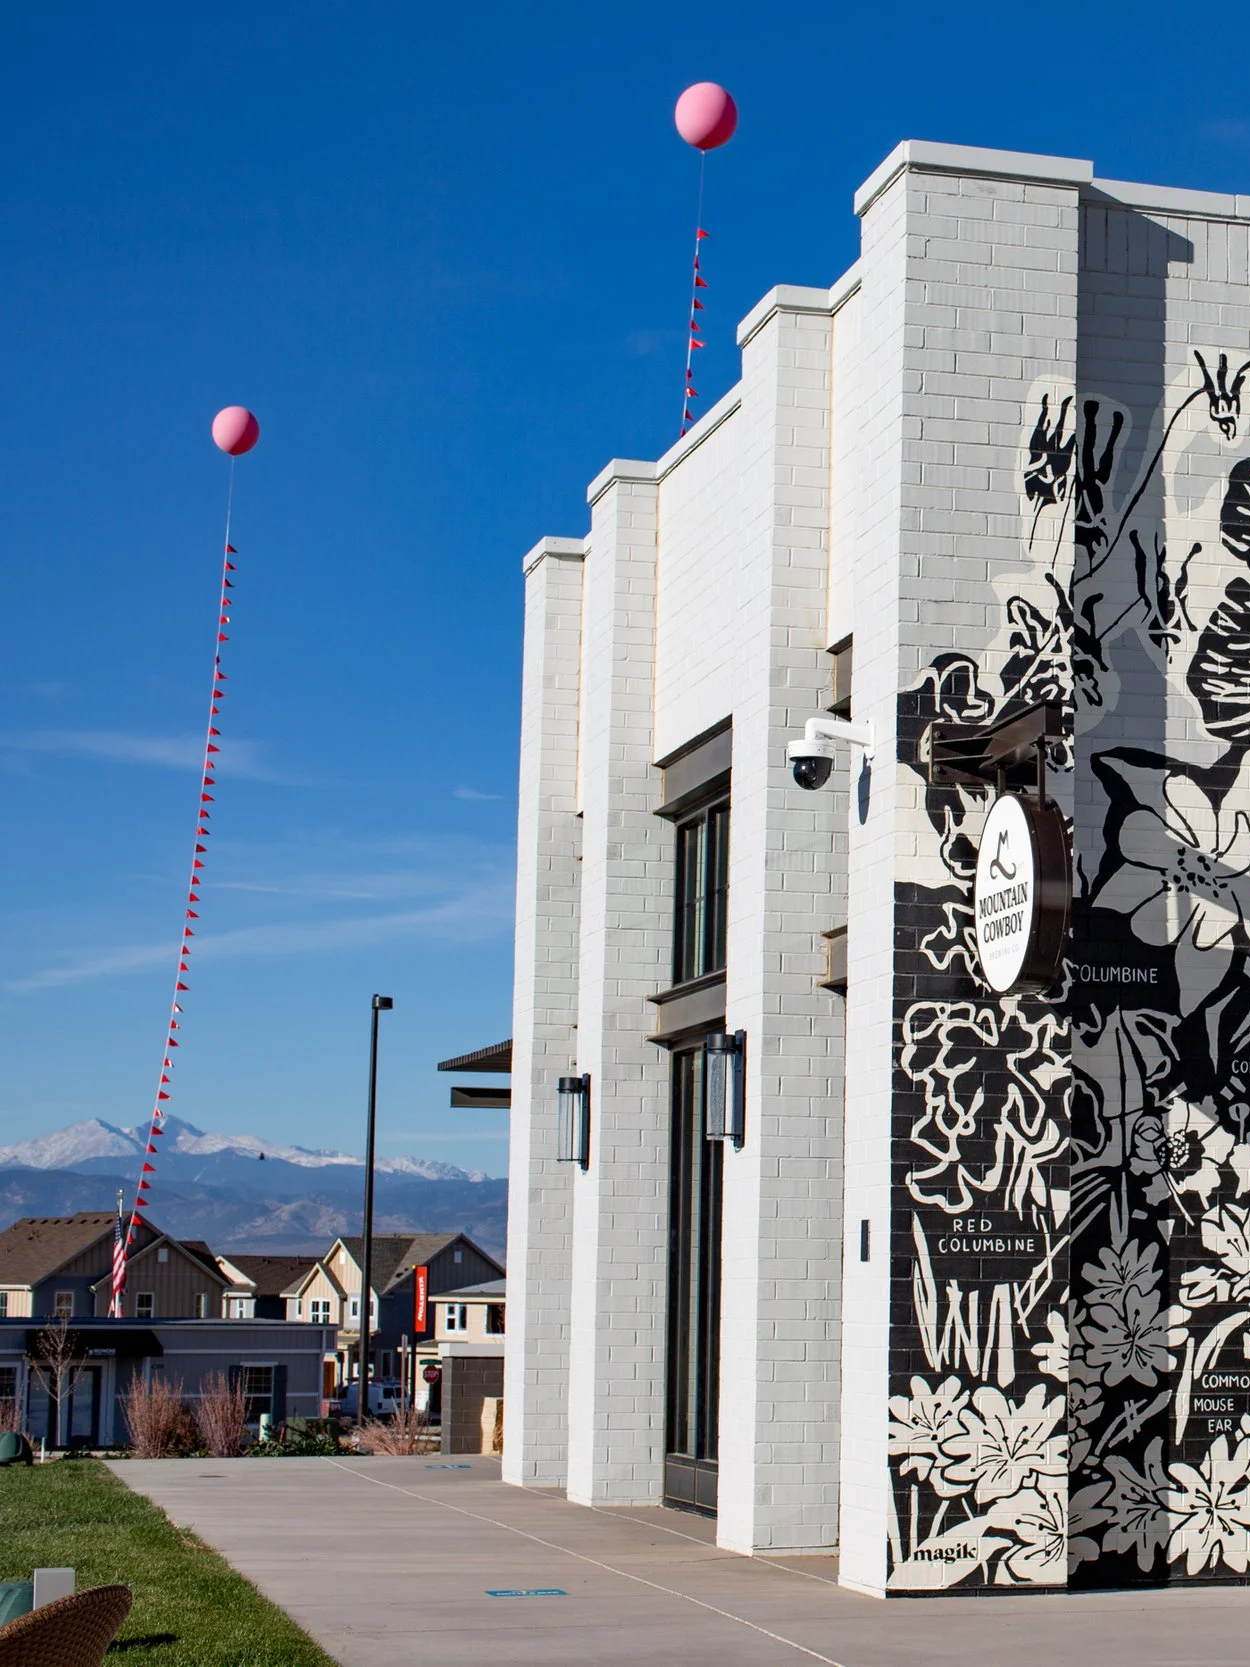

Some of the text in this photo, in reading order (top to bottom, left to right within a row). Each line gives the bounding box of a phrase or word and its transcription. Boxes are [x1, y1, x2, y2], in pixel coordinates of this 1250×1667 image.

[979, 882, 1028, 919] MOUNTAIN
[983, 911, 1024, 943] COWBOY
[953, 1219, 992, 1232] RED
[938, 1238, 1035, 1253] COLUMBINE
[424, 1370, 439, 1378] STOP
[1194, 1398, 1234, 1412] MOUSE
[1208, 1419, 1232, 1433] EAR
[913, 1543, 977, 1564] magik
